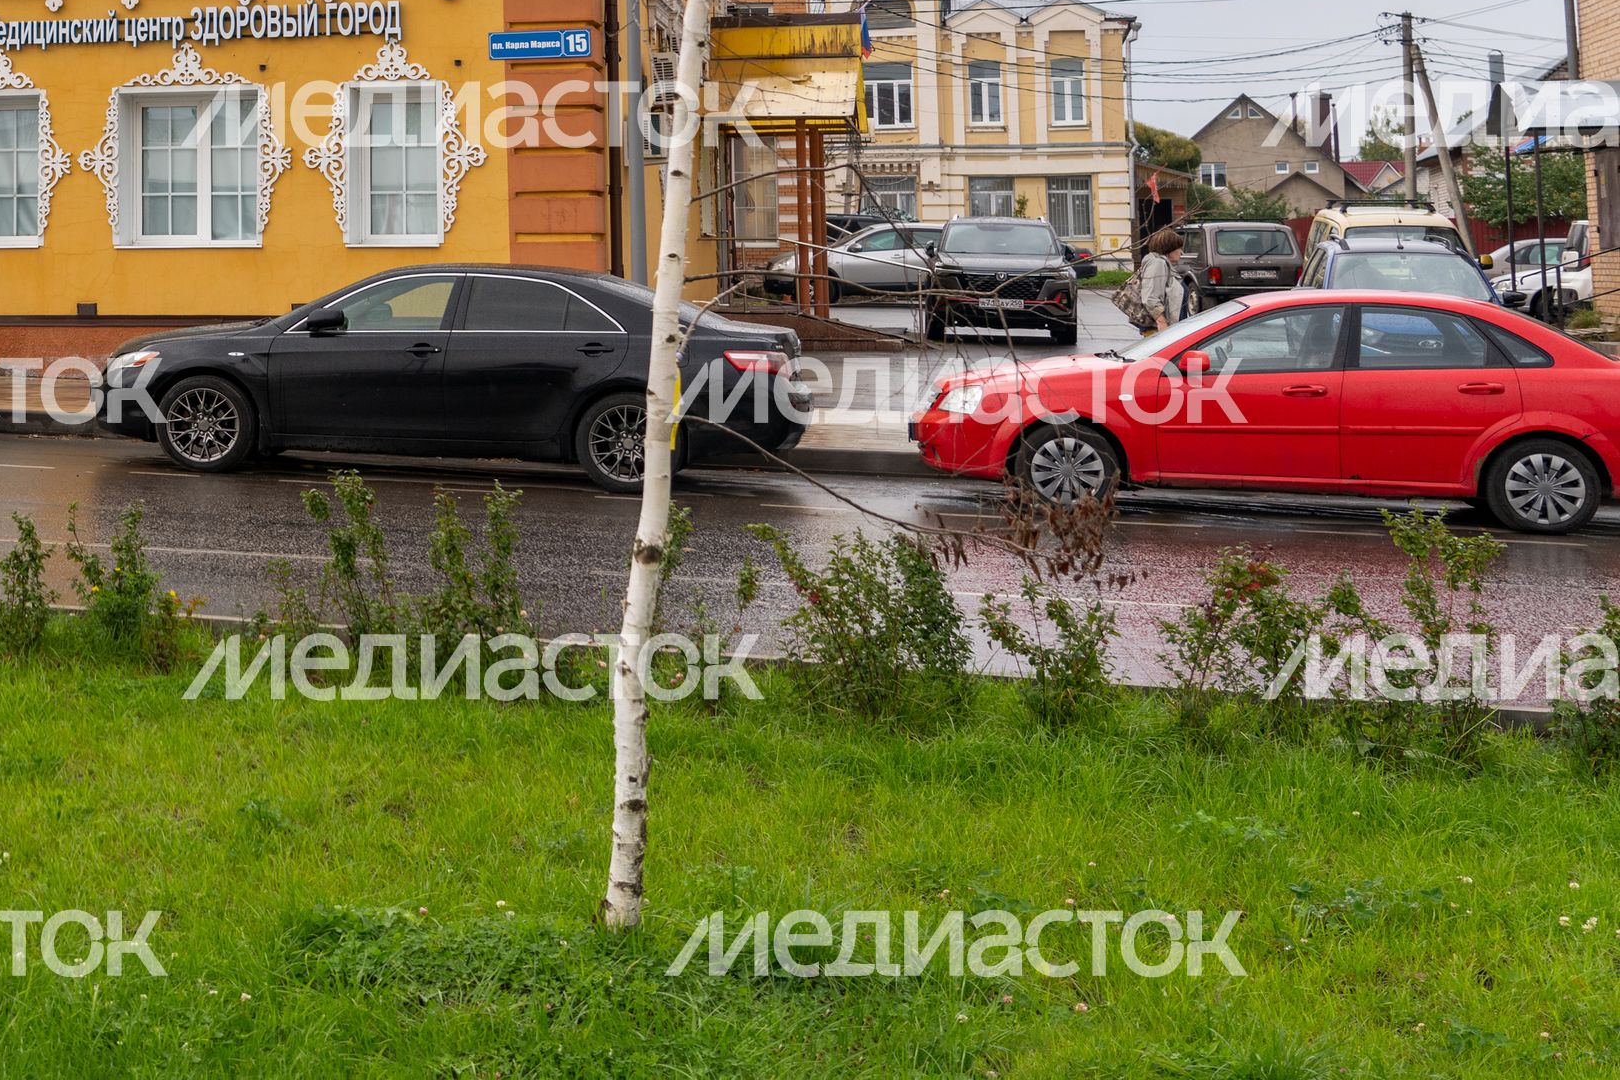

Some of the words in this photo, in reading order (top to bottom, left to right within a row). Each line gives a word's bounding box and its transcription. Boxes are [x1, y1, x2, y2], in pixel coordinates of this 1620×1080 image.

[124, 16, 186, 49] центр
[325, 1, 402, 41] ГОРОД
[492, 42, 504, 50] пл.
[505, 41, 529, 50] Карла
[530, 40, 561, 49] Маркса
[566, 33, 587, 52] 15
